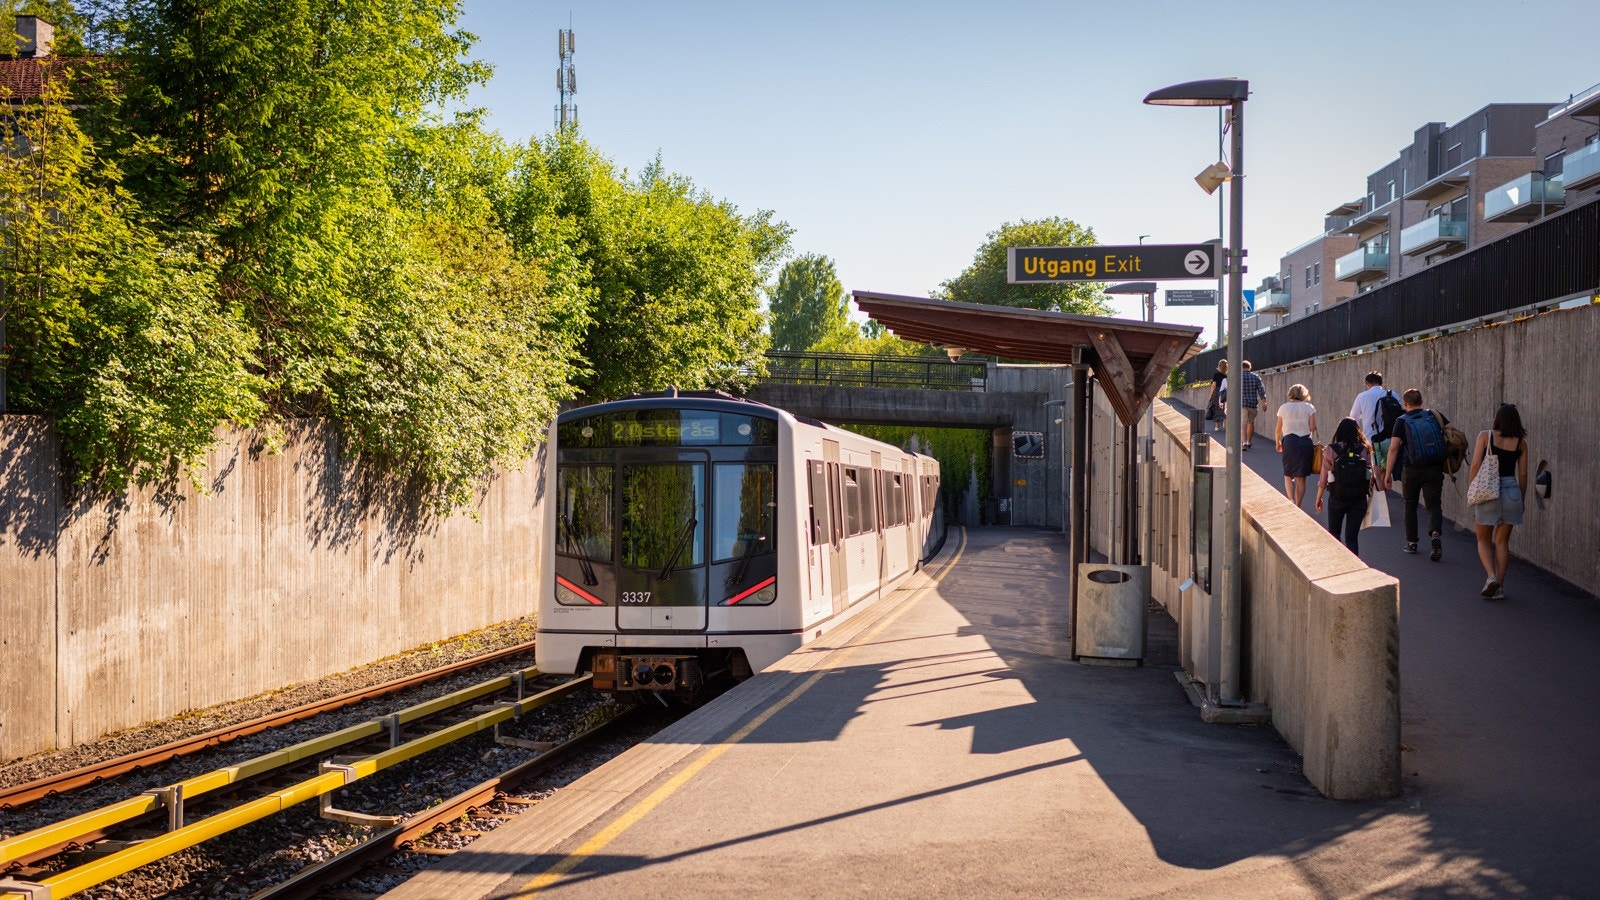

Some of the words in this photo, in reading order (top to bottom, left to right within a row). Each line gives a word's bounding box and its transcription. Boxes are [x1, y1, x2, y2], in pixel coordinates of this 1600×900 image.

[1023, 256, 1097, 278] Utgang
[1104, 255, 1142, 273] Exit
[613, 421, 624, 439] 2
[629, 421, 715, 438] Østerås
[622, 591, 651, 603] 3337
